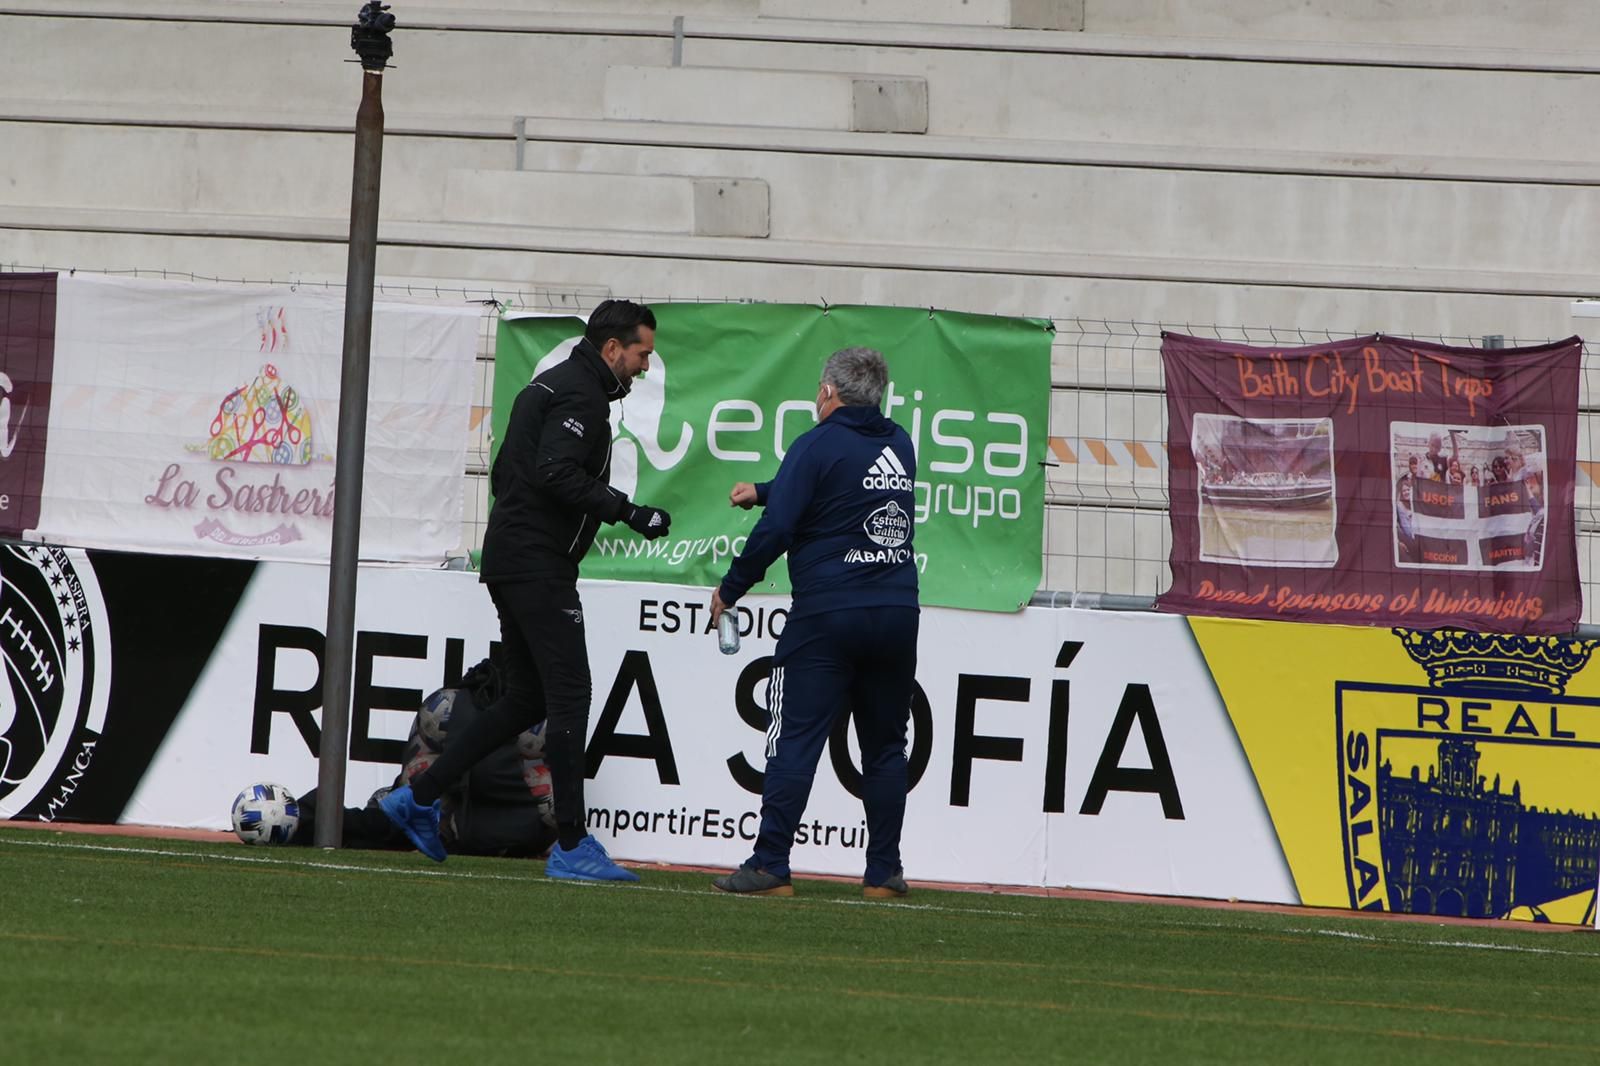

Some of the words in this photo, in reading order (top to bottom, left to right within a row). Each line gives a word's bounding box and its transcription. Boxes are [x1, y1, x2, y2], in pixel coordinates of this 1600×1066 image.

[1235, 352, 1299, 397] Bath
[1305, 350, 1361, 414] City
[1362, 347, 1423, 393] Boat
[1426, 353, 1493, 417] Trips
[706, 381, 1028, 478] ectisa
[145, 463, 200, 509] La
[206, 467, 337, 518] Sastrerí
[862, 473, 912, 492] adidas
[1484, 491, 1519, 508] FANS
[871, 515, 908, 529] Estrella
[873, 525, 905, 539] Galicia
[66, 573, 91, 632] ASPERA
[1268, 586, 1385, 614] Sponsors
[1388, 586, 1421, 616] of
[1422, 587, 1544, 621] Unionistas
[251, 623, 680, 786] REIA
[1417, 696, 1576, 739] REAL
